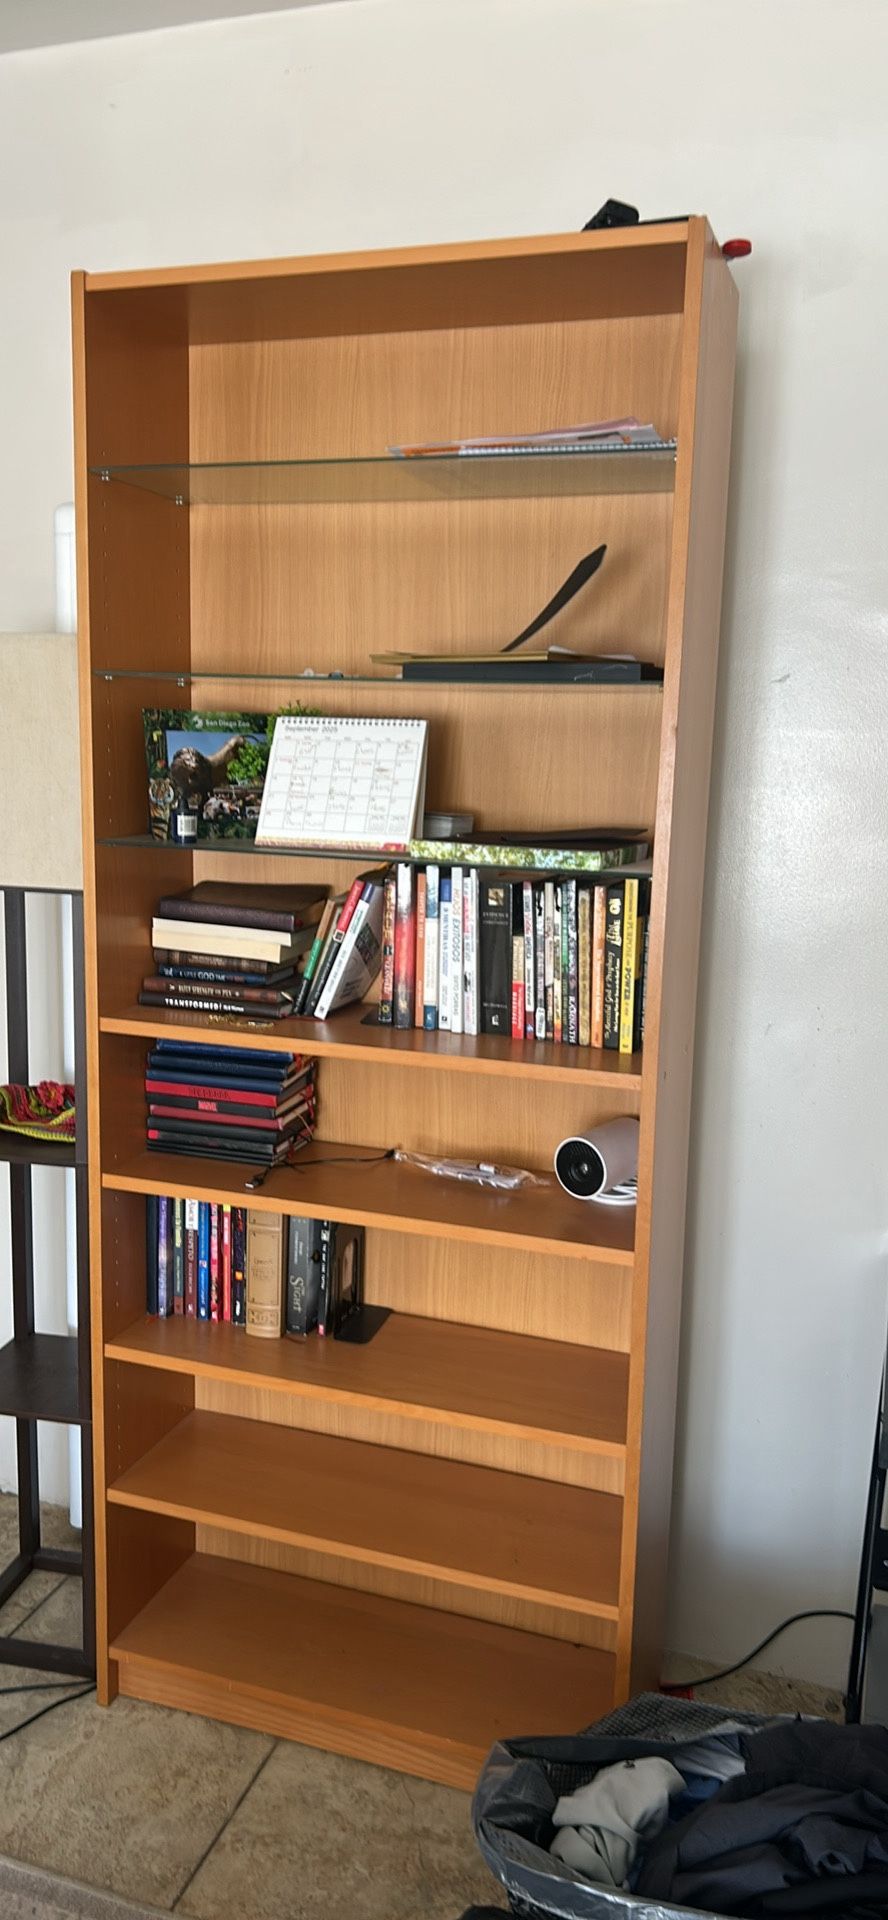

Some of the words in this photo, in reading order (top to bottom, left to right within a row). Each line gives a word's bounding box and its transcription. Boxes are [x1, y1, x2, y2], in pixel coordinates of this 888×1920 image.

[205, 719, 218, 727] San
[219, 719, 237, 728] Diego
[284, 725, 319, 733] September
[452, 917, 461, 963] EXITOSOS
[197, 971, 215, 980] GOD
[623, 966, 632, 1000] POWER
[605, 989, 613, 1004] God
[165, 998, 219, 1011] TRANSFORMED
[289, 1275, 305, 1313] SIGHT
